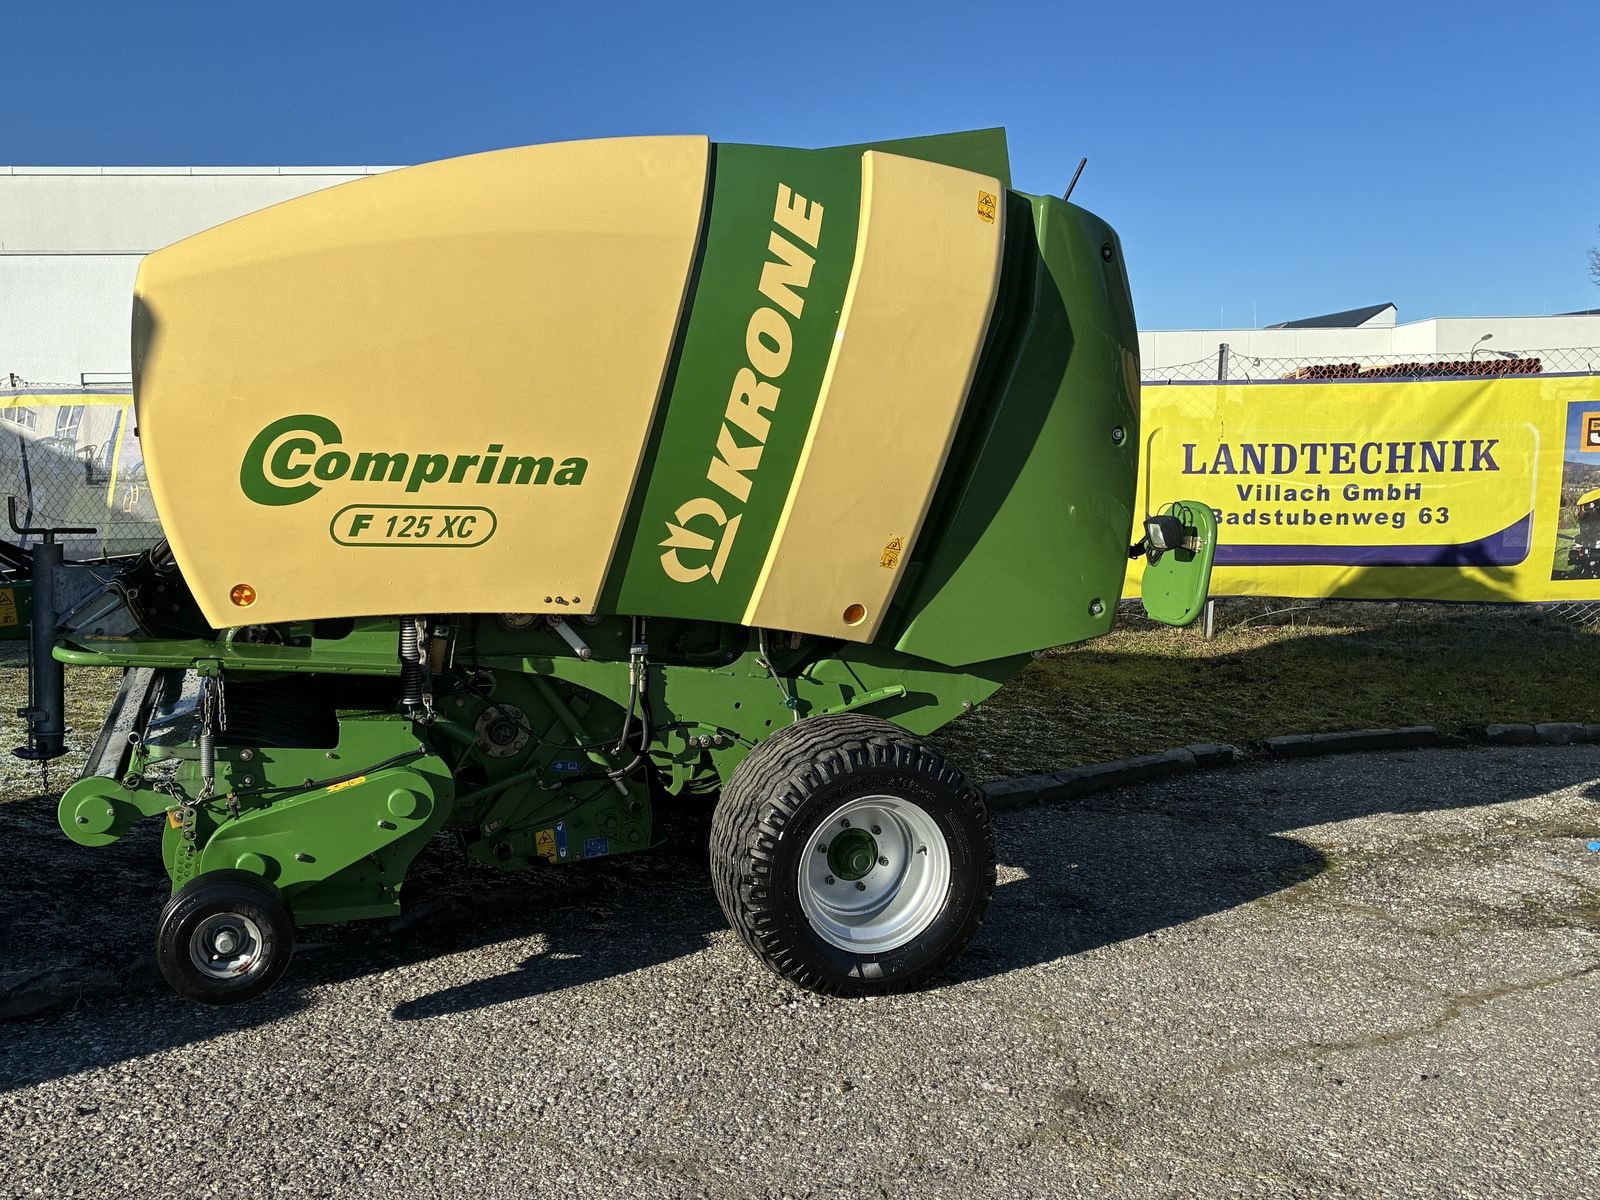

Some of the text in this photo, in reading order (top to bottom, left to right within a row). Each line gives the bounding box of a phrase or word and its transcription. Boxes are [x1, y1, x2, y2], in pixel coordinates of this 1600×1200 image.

[706, 182, 824, 503] KRONE
[1182, 440, 1500, 475] LANDTECHNIK
[1236, 483, 1422, 502] Villach GmbH
[348, 514, 477, 538] F 125 XC
[1212, 507, 1450, 528] Badstubenweg 63
